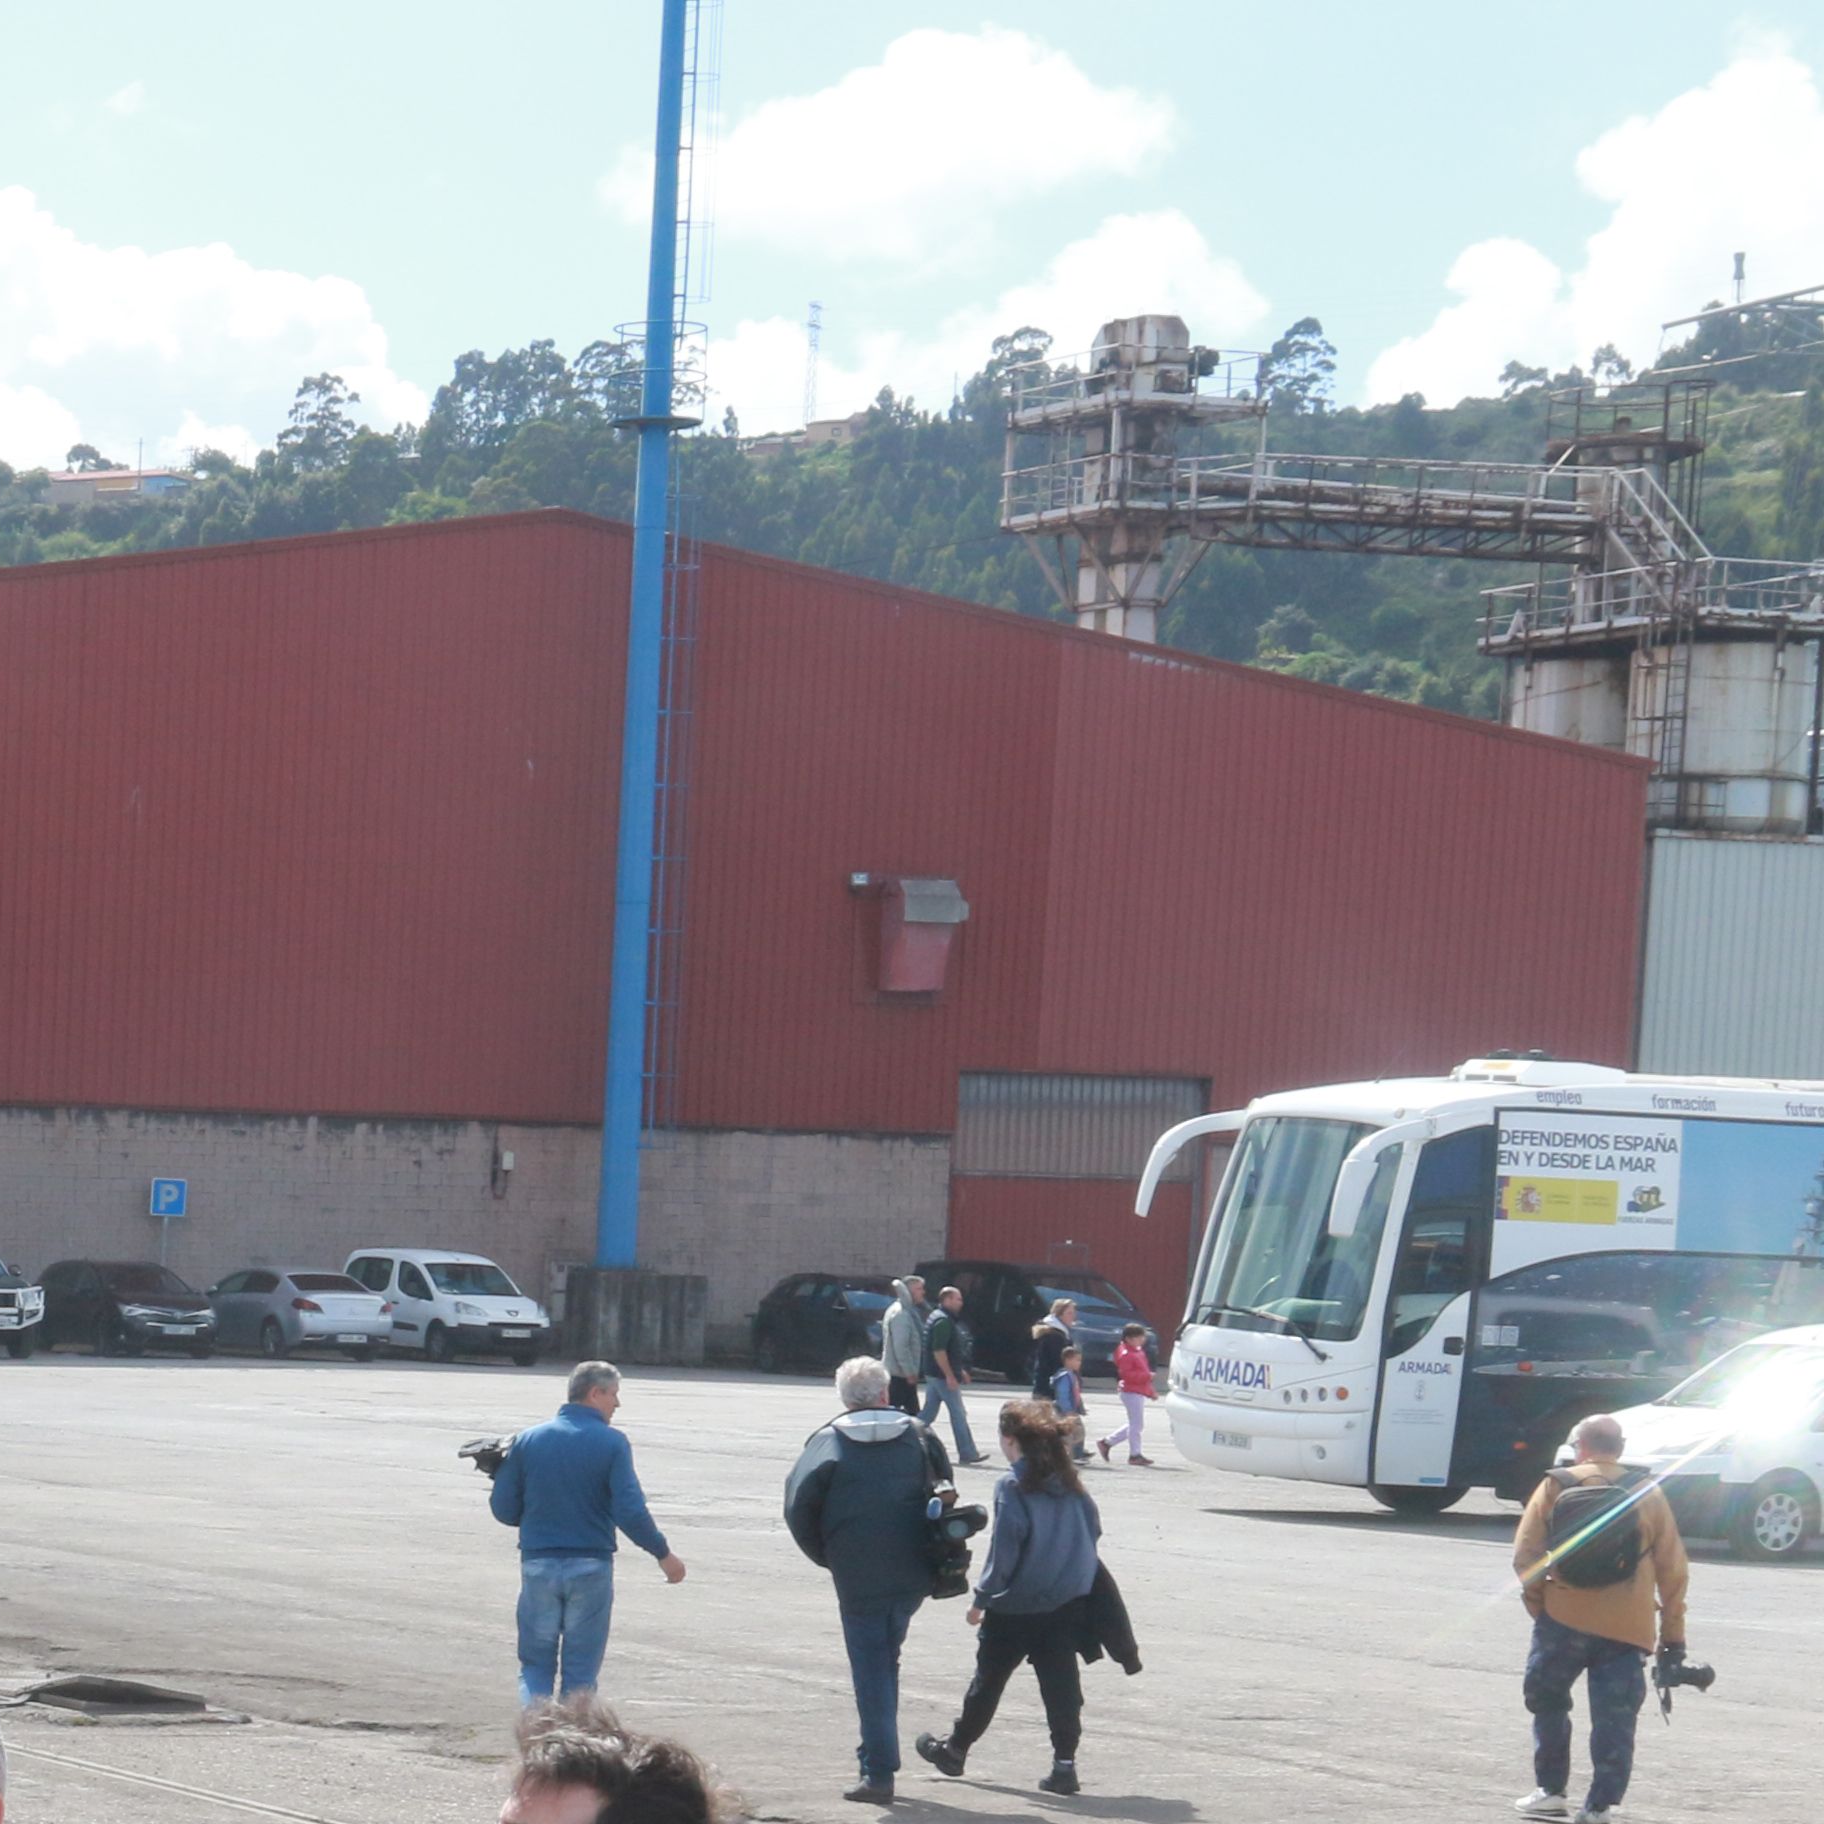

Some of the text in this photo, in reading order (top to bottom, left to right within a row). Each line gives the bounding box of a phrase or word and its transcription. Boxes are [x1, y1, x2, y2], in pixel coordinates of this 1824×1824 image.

[1536, 1090, 1583, 1106] empleo
[1651, 1093, 1717, 1112] formación
[1499, 1129, 1679, 1153] DEFENDEMOS ESPAÑA
[1498, 1150, 1656, 1173] EN Y DESDE LA MAR
[159, 1184, 179, 1211] P
[1192, 1356, 1267, 1389] ARMADA
[1398, 1361, 1447, 1375] ARMADA
